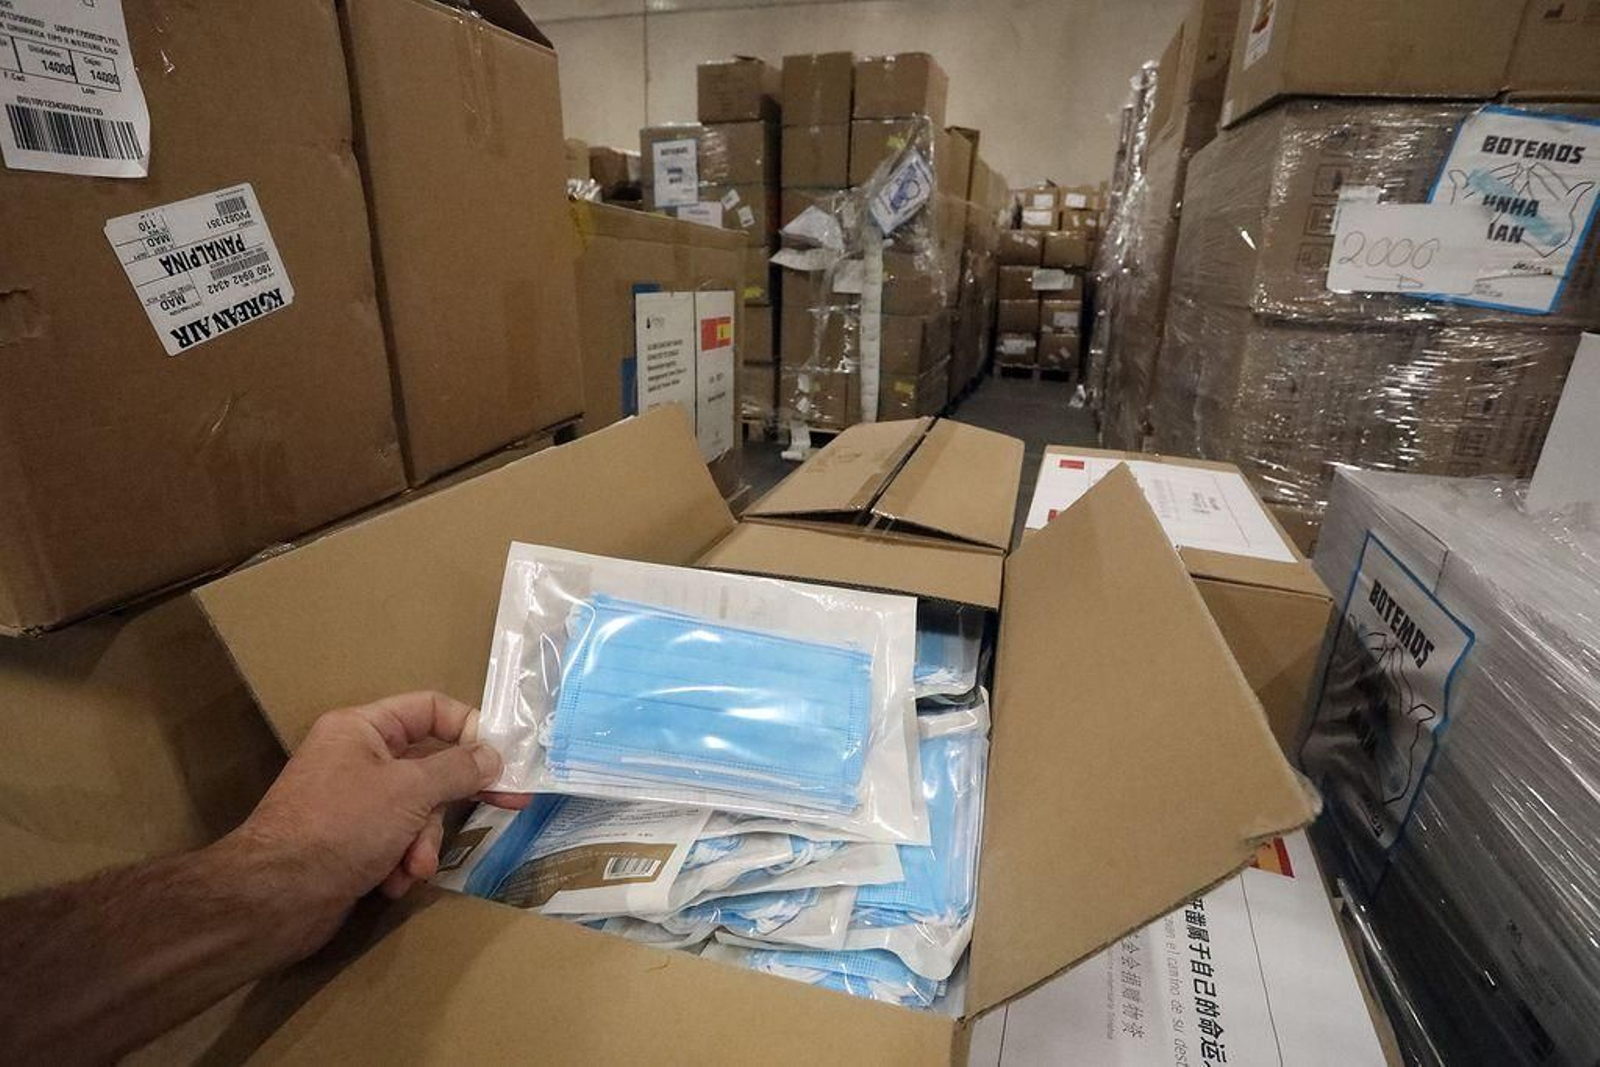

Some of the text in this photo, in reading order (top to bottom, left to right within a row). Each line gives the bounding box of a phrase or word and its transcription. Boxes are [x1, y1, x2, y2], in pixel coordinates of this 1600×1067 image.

[1481, 135, 1587, 164] BOTEMOS
[139, 219, 157, 231] 110
[148, 233, 171, 248] MAD
[158, 233, 246, 276] PANALPINA
[1337, 231, 1440, 270] 2000
[160, 294, 186, 311] MAD
[170, 287, 285, 347] KOREAN AIR
[1368, 579, 1434, 669] BOTEMOS
